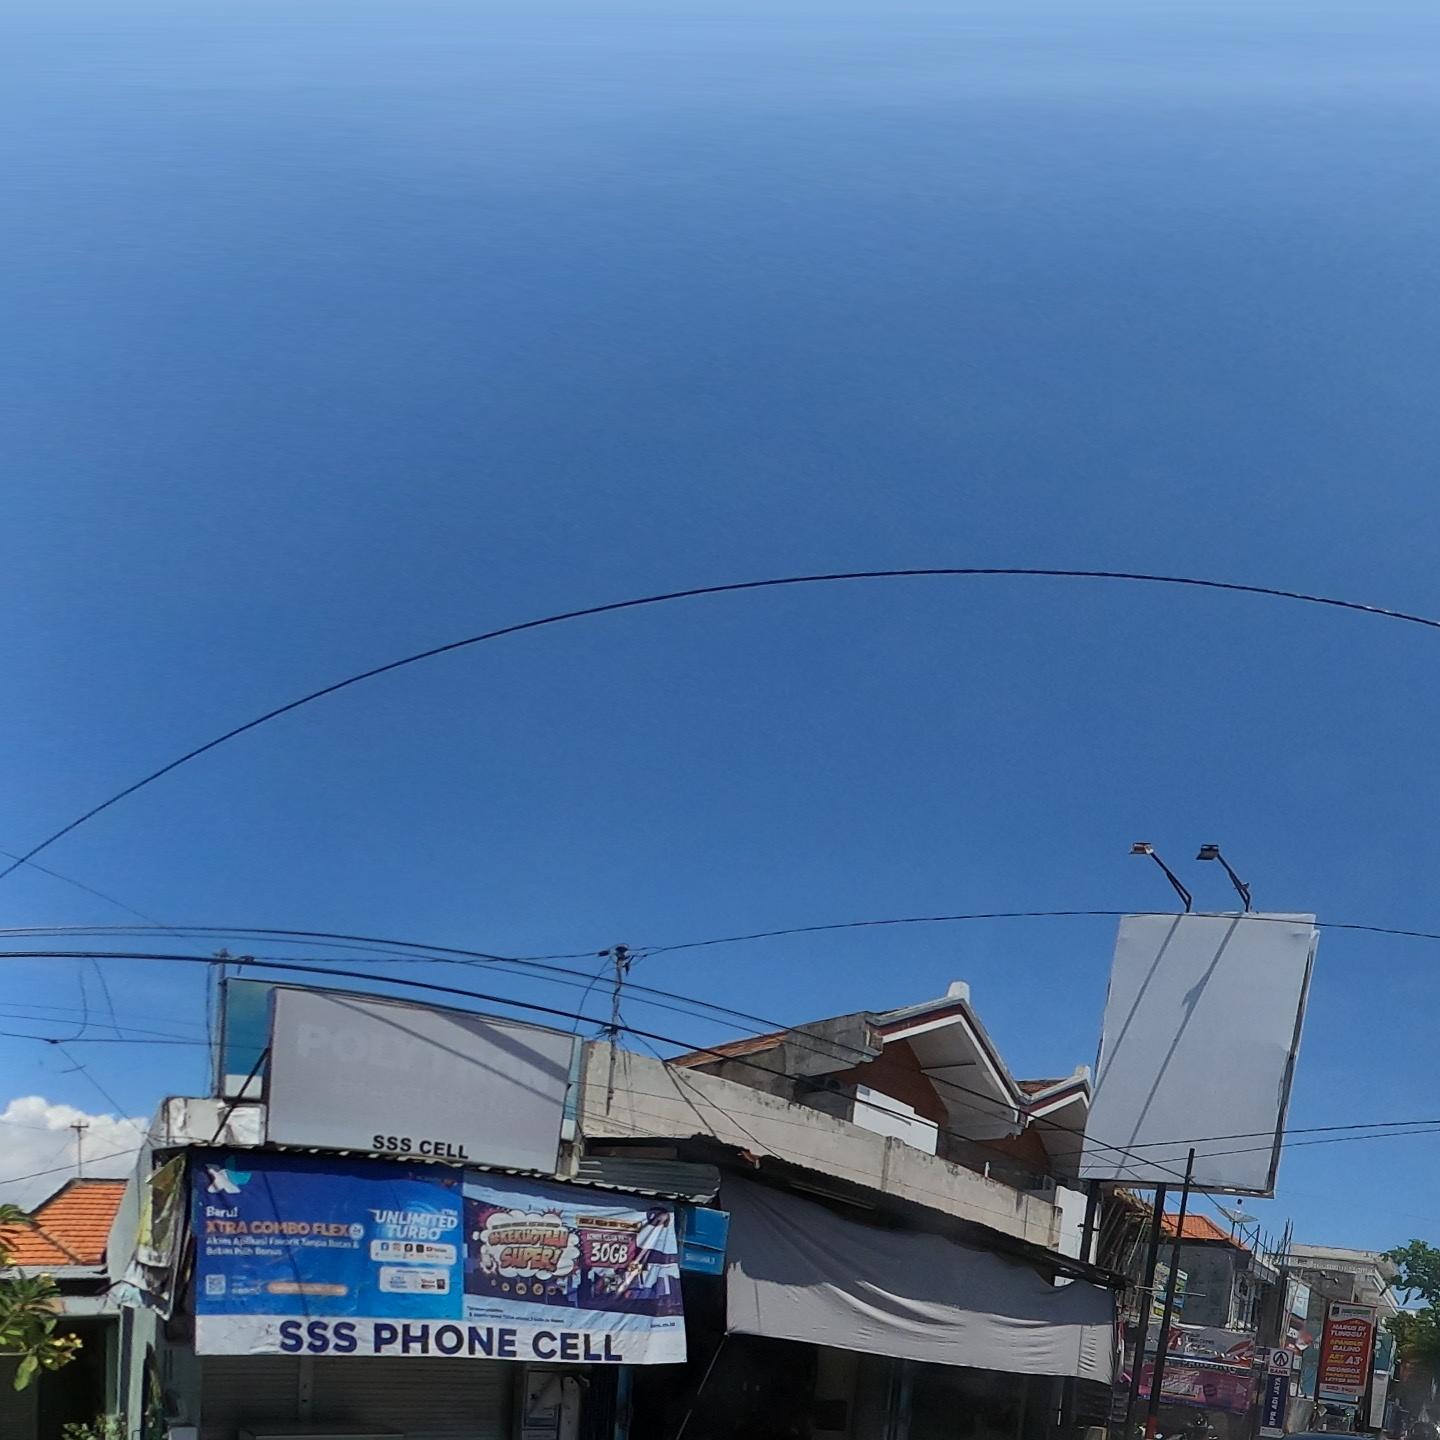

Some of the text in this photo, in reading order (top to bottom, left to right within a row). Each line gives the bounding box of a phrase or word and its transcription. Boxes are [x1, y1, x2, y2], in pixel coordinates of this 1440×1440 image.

[372, 1134, 469, 1160] SSS CELL
[206, 1206, 238, 1218] Baru!
[372, 1209, 458, 1229] UNLIMITED
[206, 1220, 349, 1237] XTRA COMBO FLEX
[387, 1224, 442, 1241] TURBO
[500, 1247, 561, 1272] SUPER!
[591, 1242, 629, 1264] 30GB
[279, 1320, 623, 1362] SSS PHONE CELL
